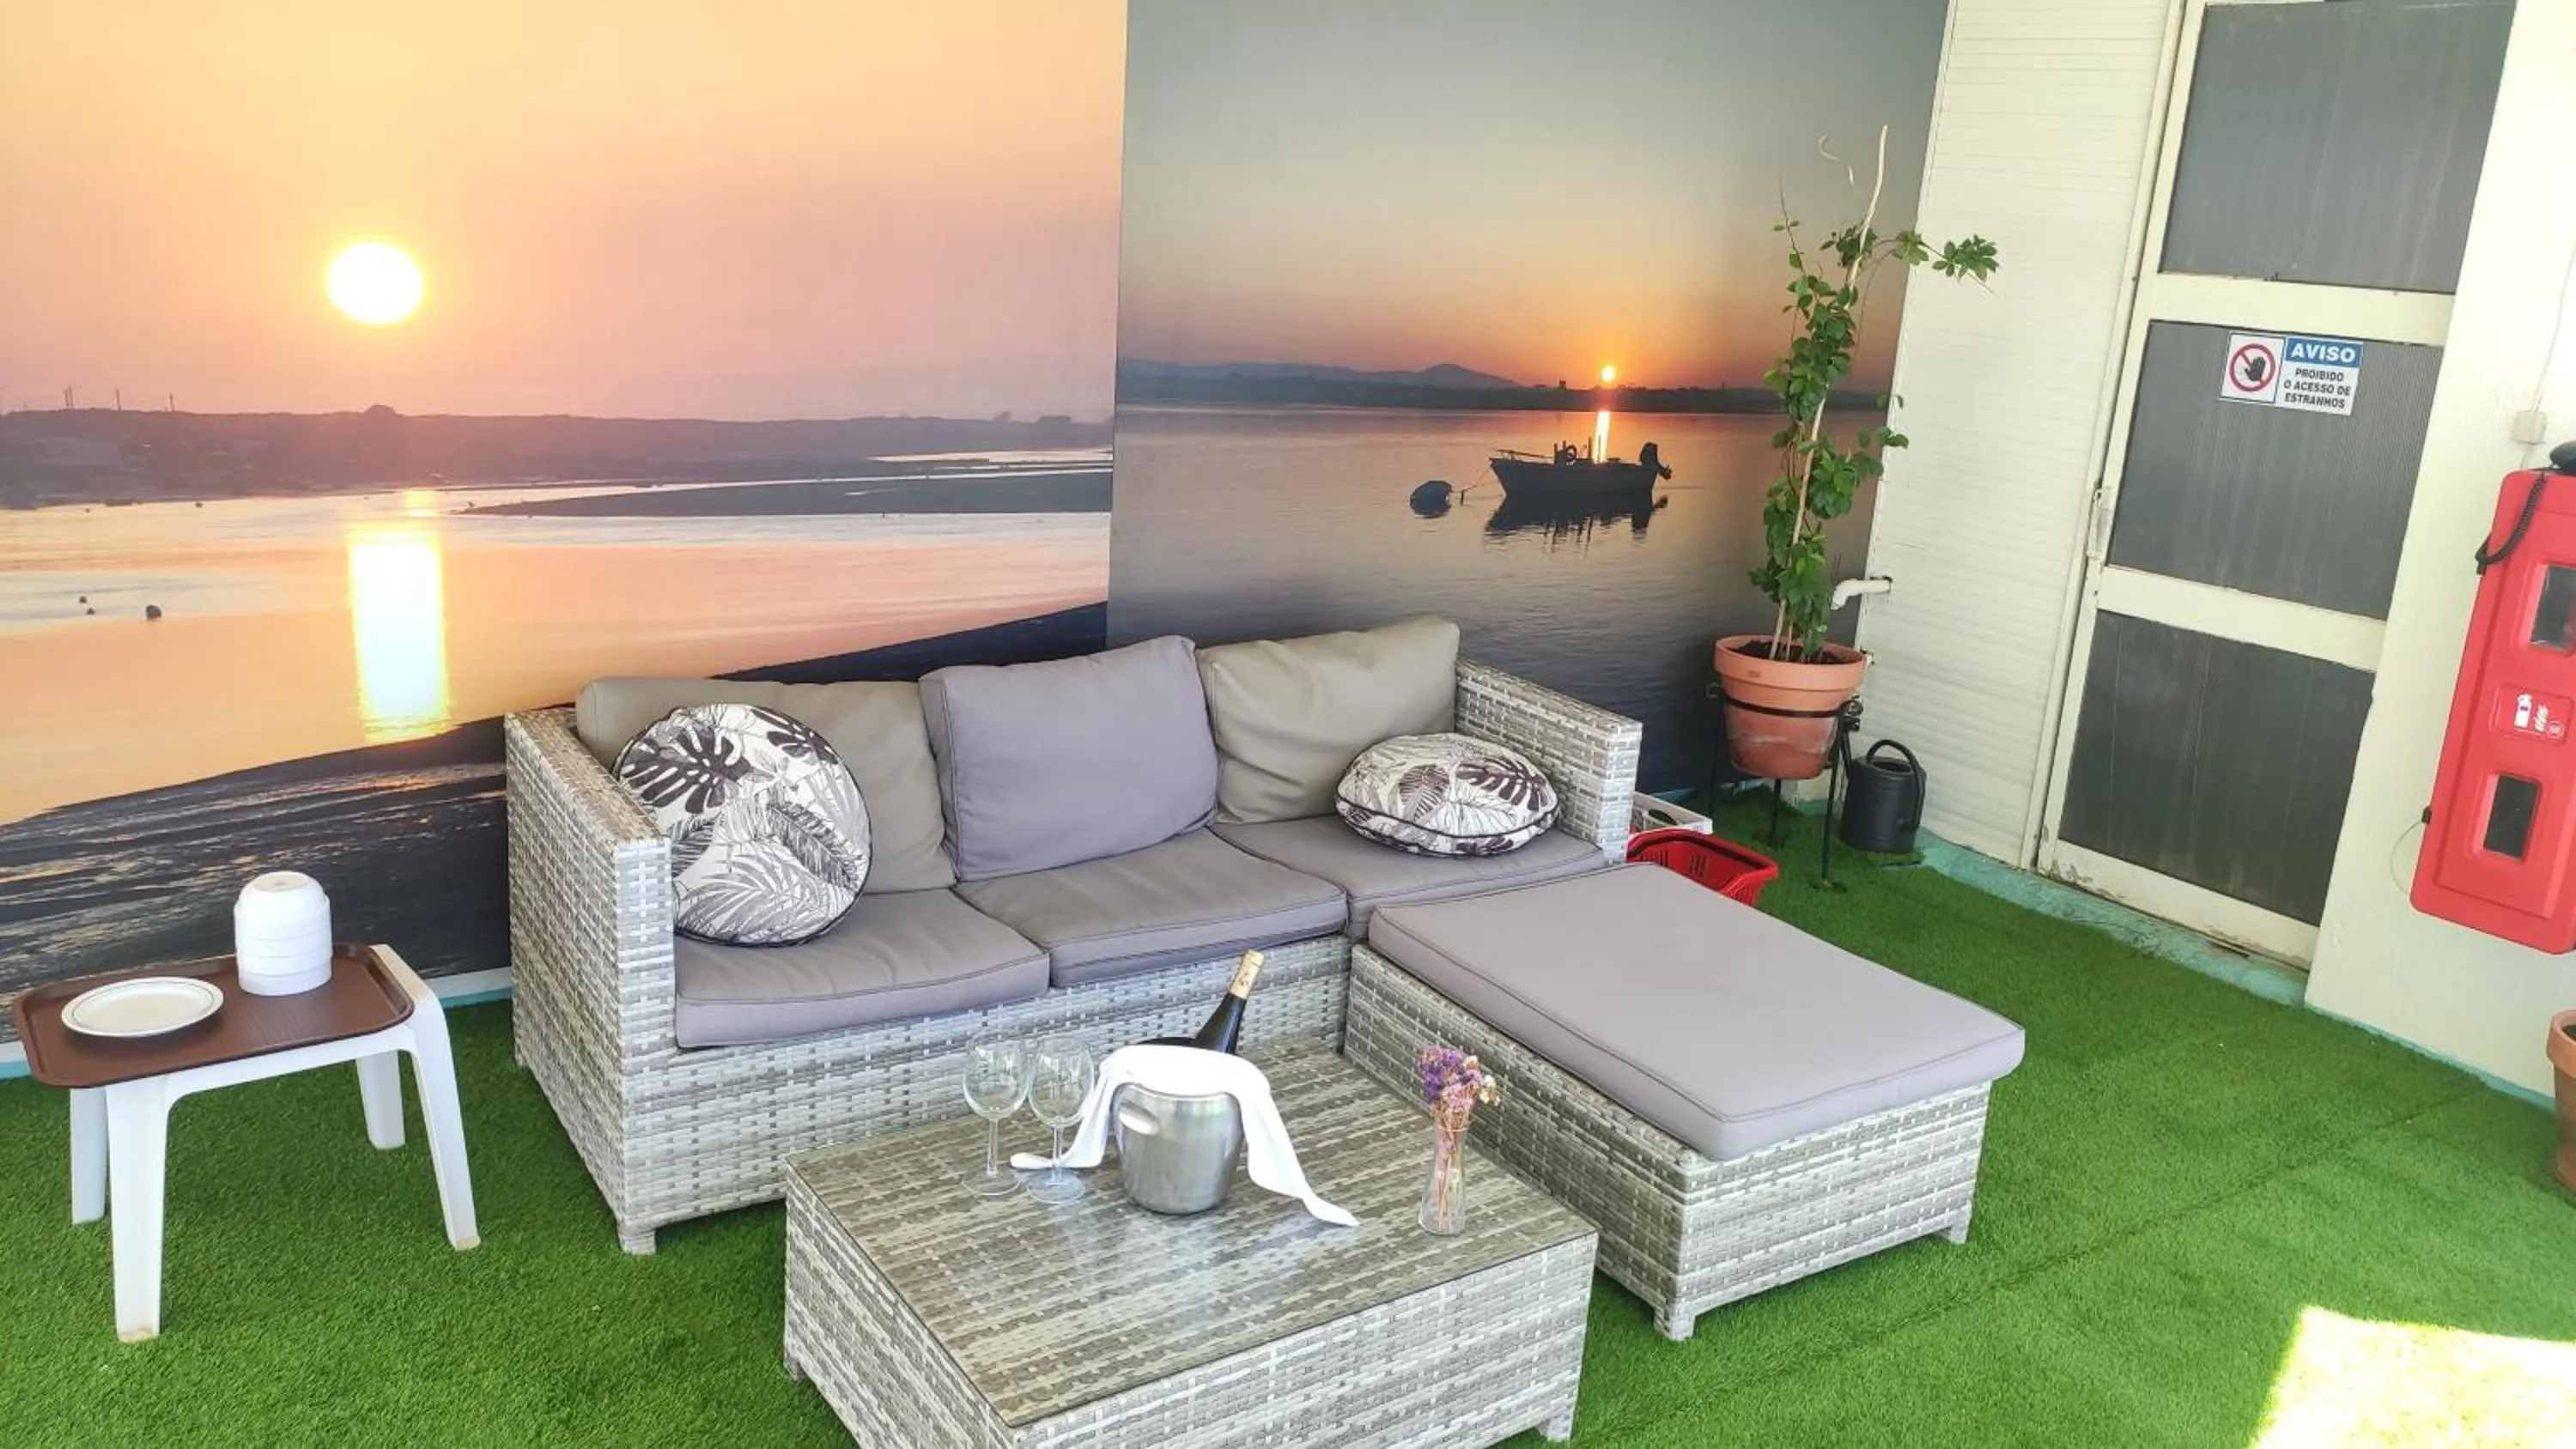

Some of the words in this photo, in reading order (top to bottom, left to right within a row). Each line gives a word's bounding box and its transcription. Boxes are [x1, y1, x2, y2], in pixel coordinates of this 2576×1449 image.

[2290, 343, 2355, 363] AVISO
[2295, 367, 2344, 382] PROIBIDO
[2283, 379, 2292, 389] O
[2293, 381, 2335, 394] ACESSO
[2337, 385, 2351, 396] DE
[2285, 392, 2345, 409] ESTRANHOS
